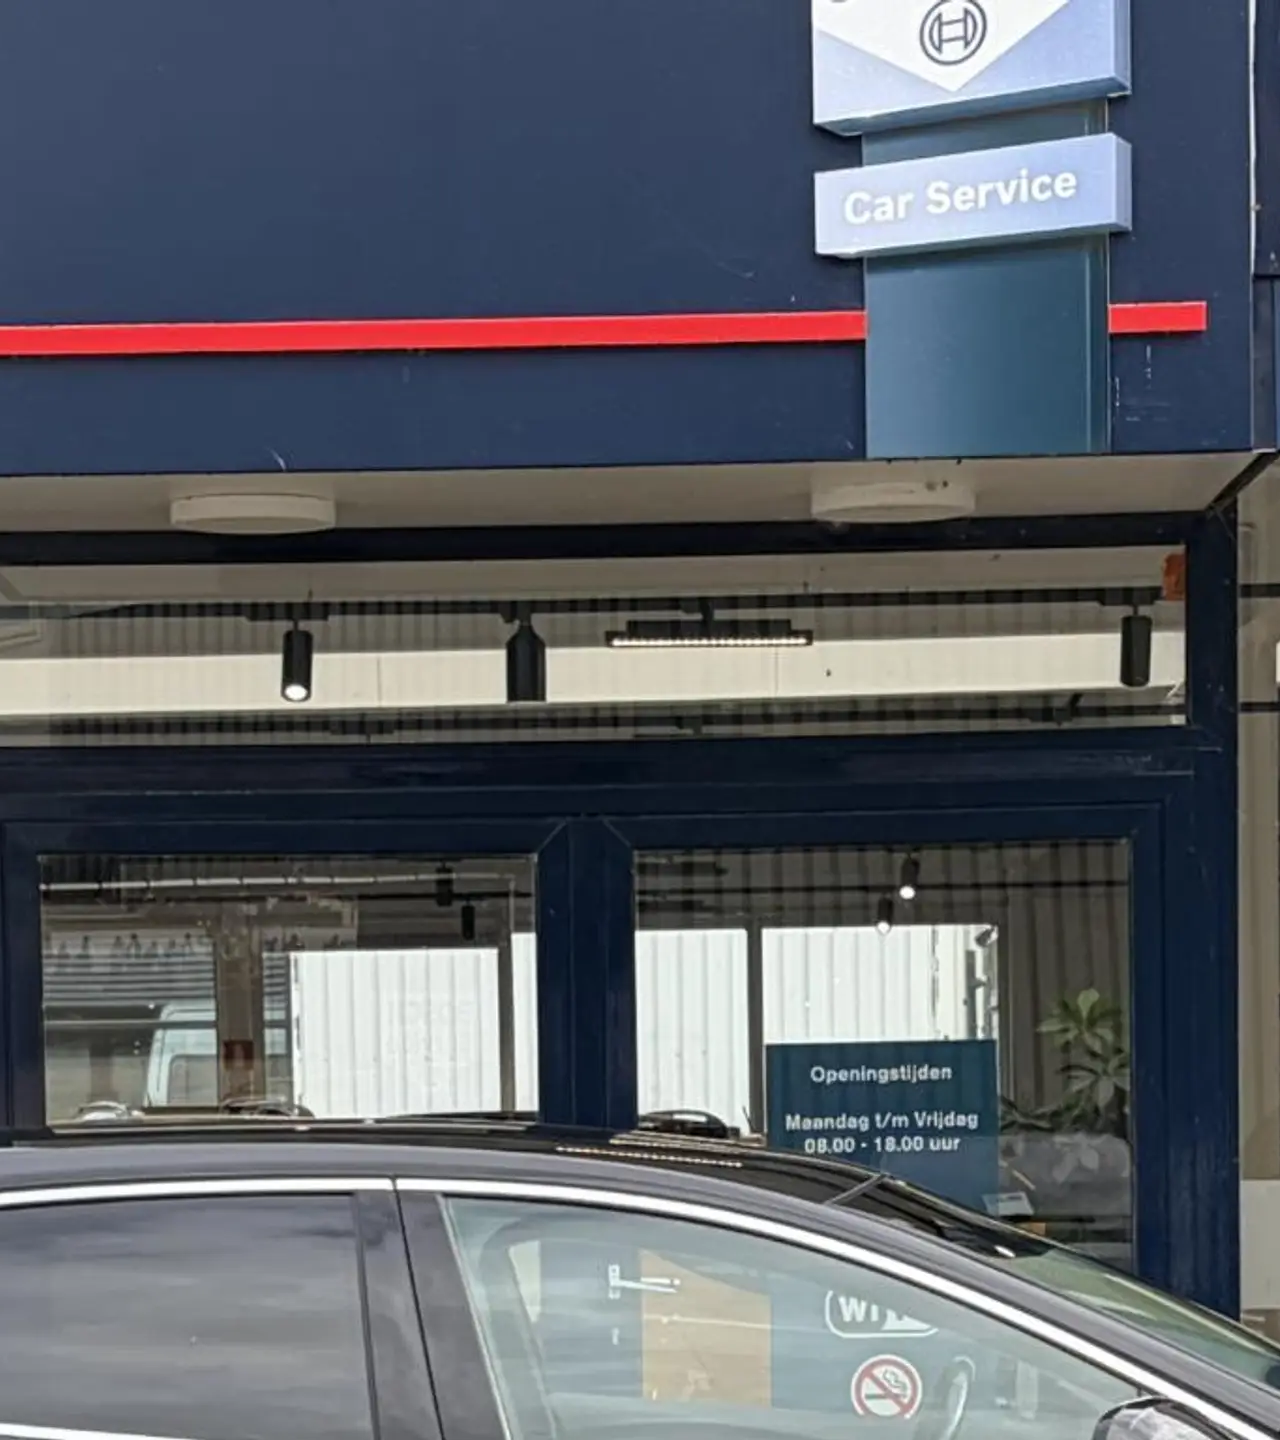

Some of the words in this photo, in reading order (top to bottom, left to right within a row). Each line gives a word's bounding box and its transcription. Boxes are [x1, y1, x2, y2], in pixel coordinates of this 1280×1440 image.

[843, 190, 914, 225] Car
[925, 167, 1078, 215] Service
[810, 1064, 953, 1084] Openingstijden
[785, 1113, 869, 1131] Maandag
[875, 1112, 909, 1129] t/m
[914, 1111, 979, 1130] Vrijdag
[874, 1136, 925, 1152] 18.00
[929, 1136, 961, 1150] uur
